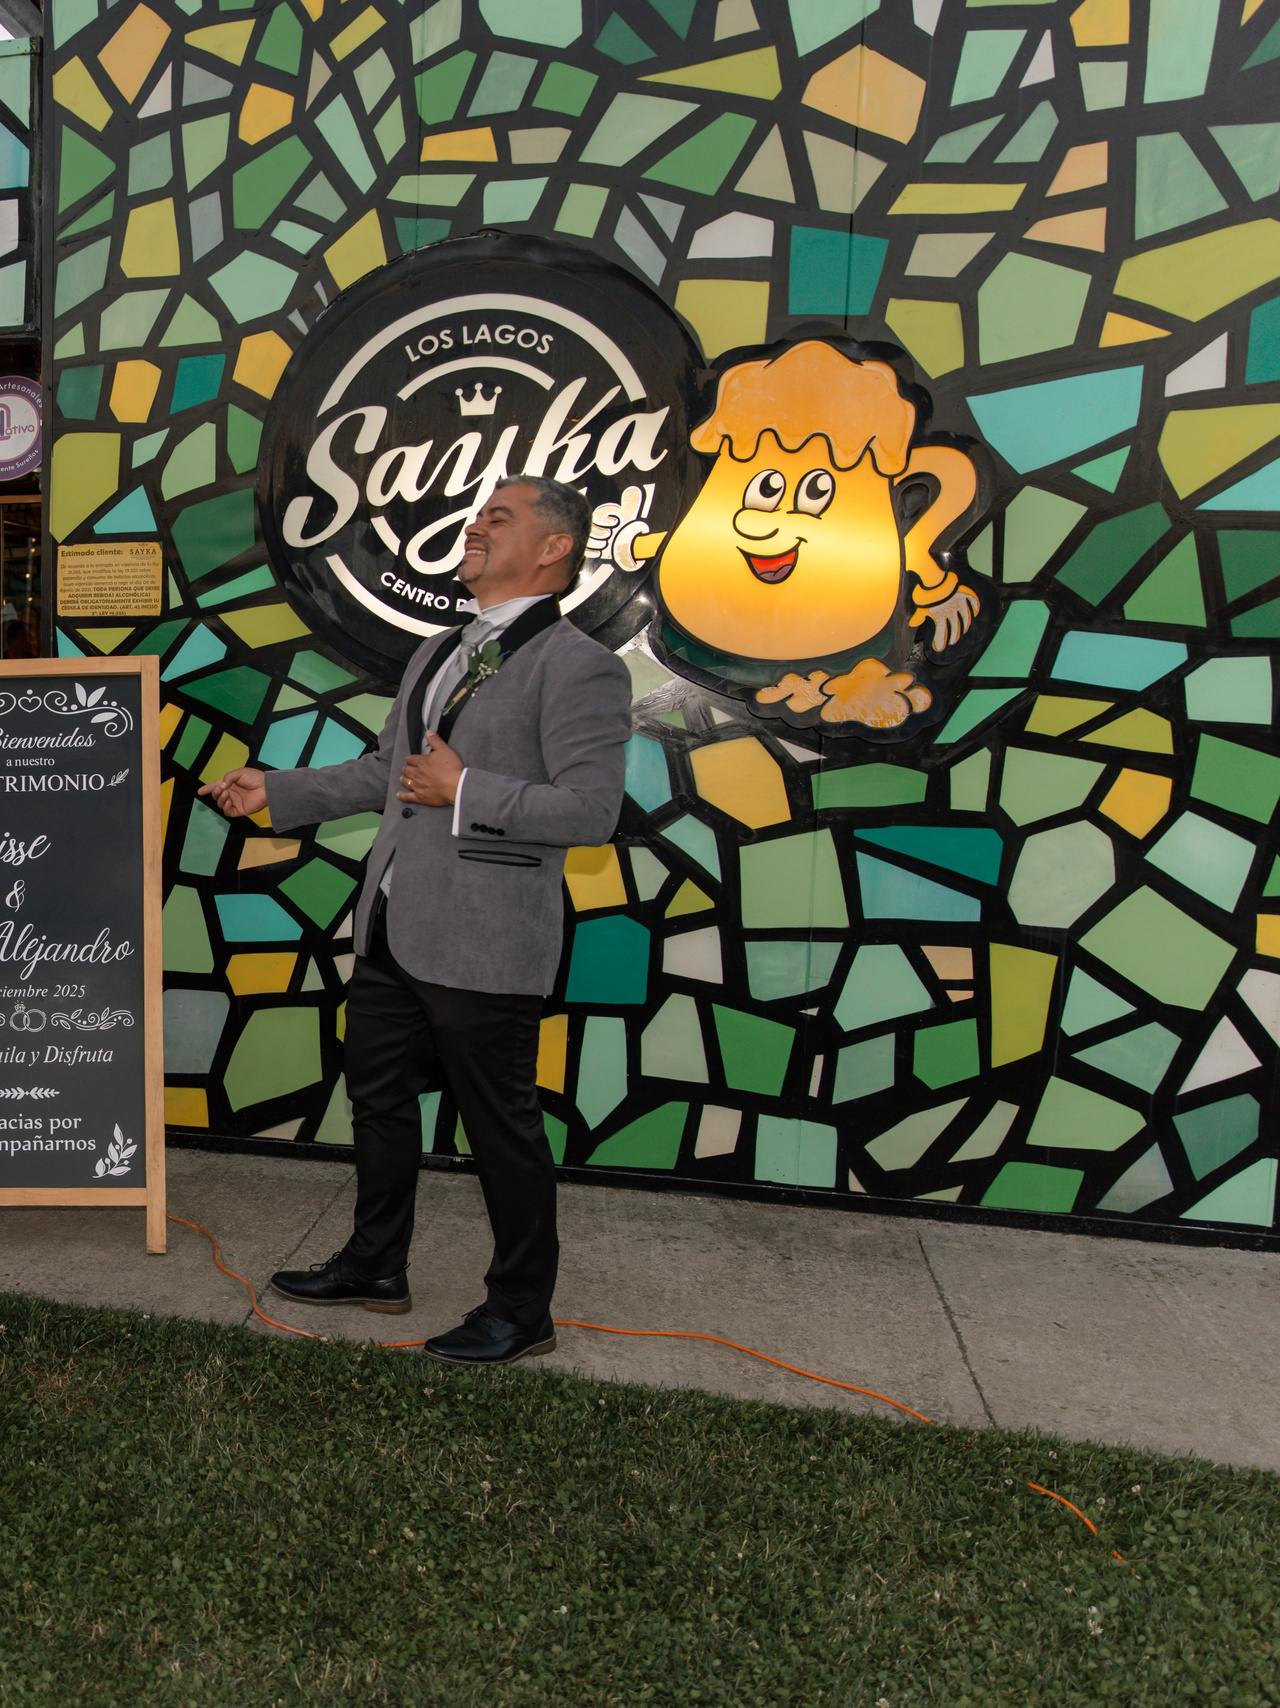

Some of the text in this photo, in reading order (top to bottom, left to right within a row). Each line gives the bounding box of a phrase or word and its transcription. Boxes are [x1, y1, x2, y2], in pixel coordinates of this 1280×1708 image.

[404, 323, 555, 363] LOS LAGOS
[281, 376, 671, 576] Sayka
[129, 548, 157, 556] SAYKA
[380, 571, 451, 610] CENTRO
[6, 756, 55, 767] a nuestro
[5, 879, 26, 912] &
[53, 984, 86, 998] 2025
[28, 1050, 40, 1067] y
[43, 1045, 114, 1066] Disfruta
[49, 1117, 82, 1135] por
